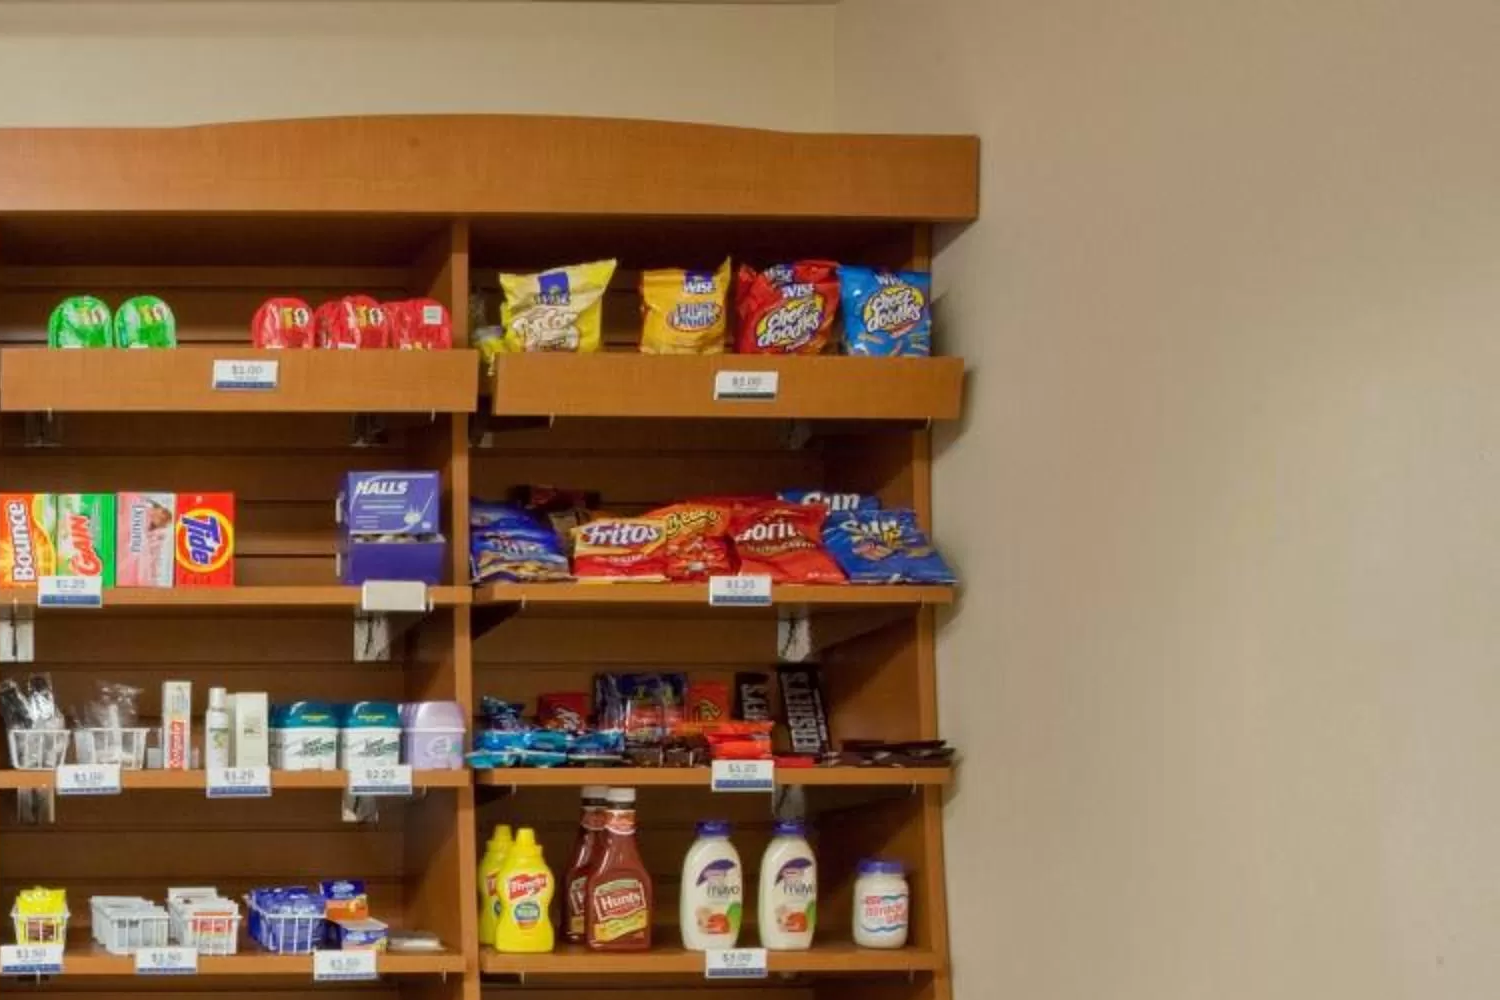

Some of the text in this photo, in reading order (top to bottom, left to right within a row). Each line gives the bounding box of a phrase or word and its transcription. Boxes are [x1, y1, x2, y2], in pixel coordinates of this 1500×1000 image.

[355, 480, 409, 495] HALLS
[9, 501, 35, 581] Bounce
[181, 515, 221, 567] Tide
